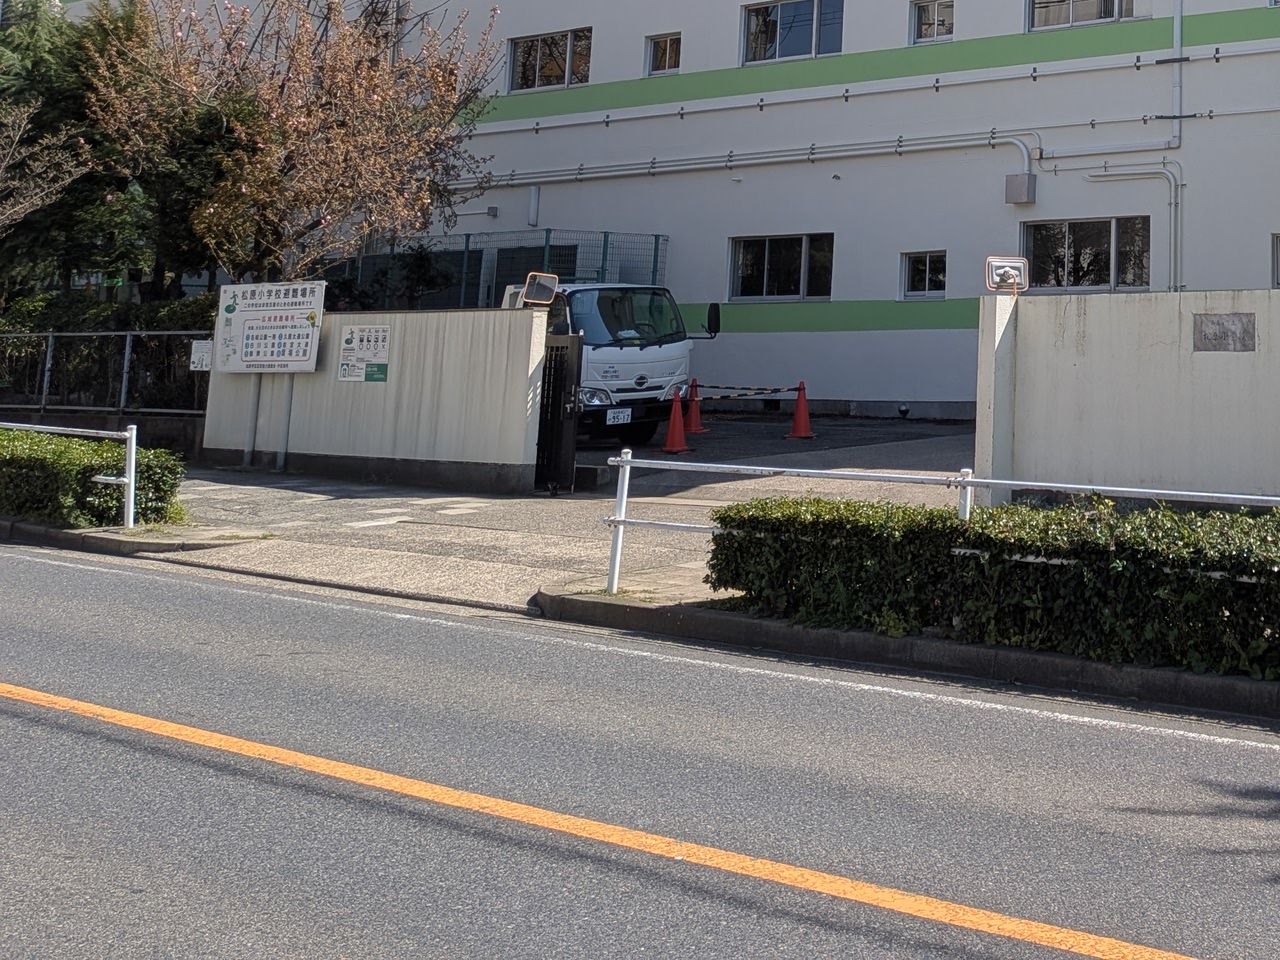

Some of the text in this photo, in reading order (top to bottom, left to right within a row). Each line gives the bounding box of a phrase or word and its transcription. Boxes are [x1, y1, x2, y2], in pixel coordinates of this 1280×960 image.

[241, 287, 316, 300] 松原小学校避難場所
